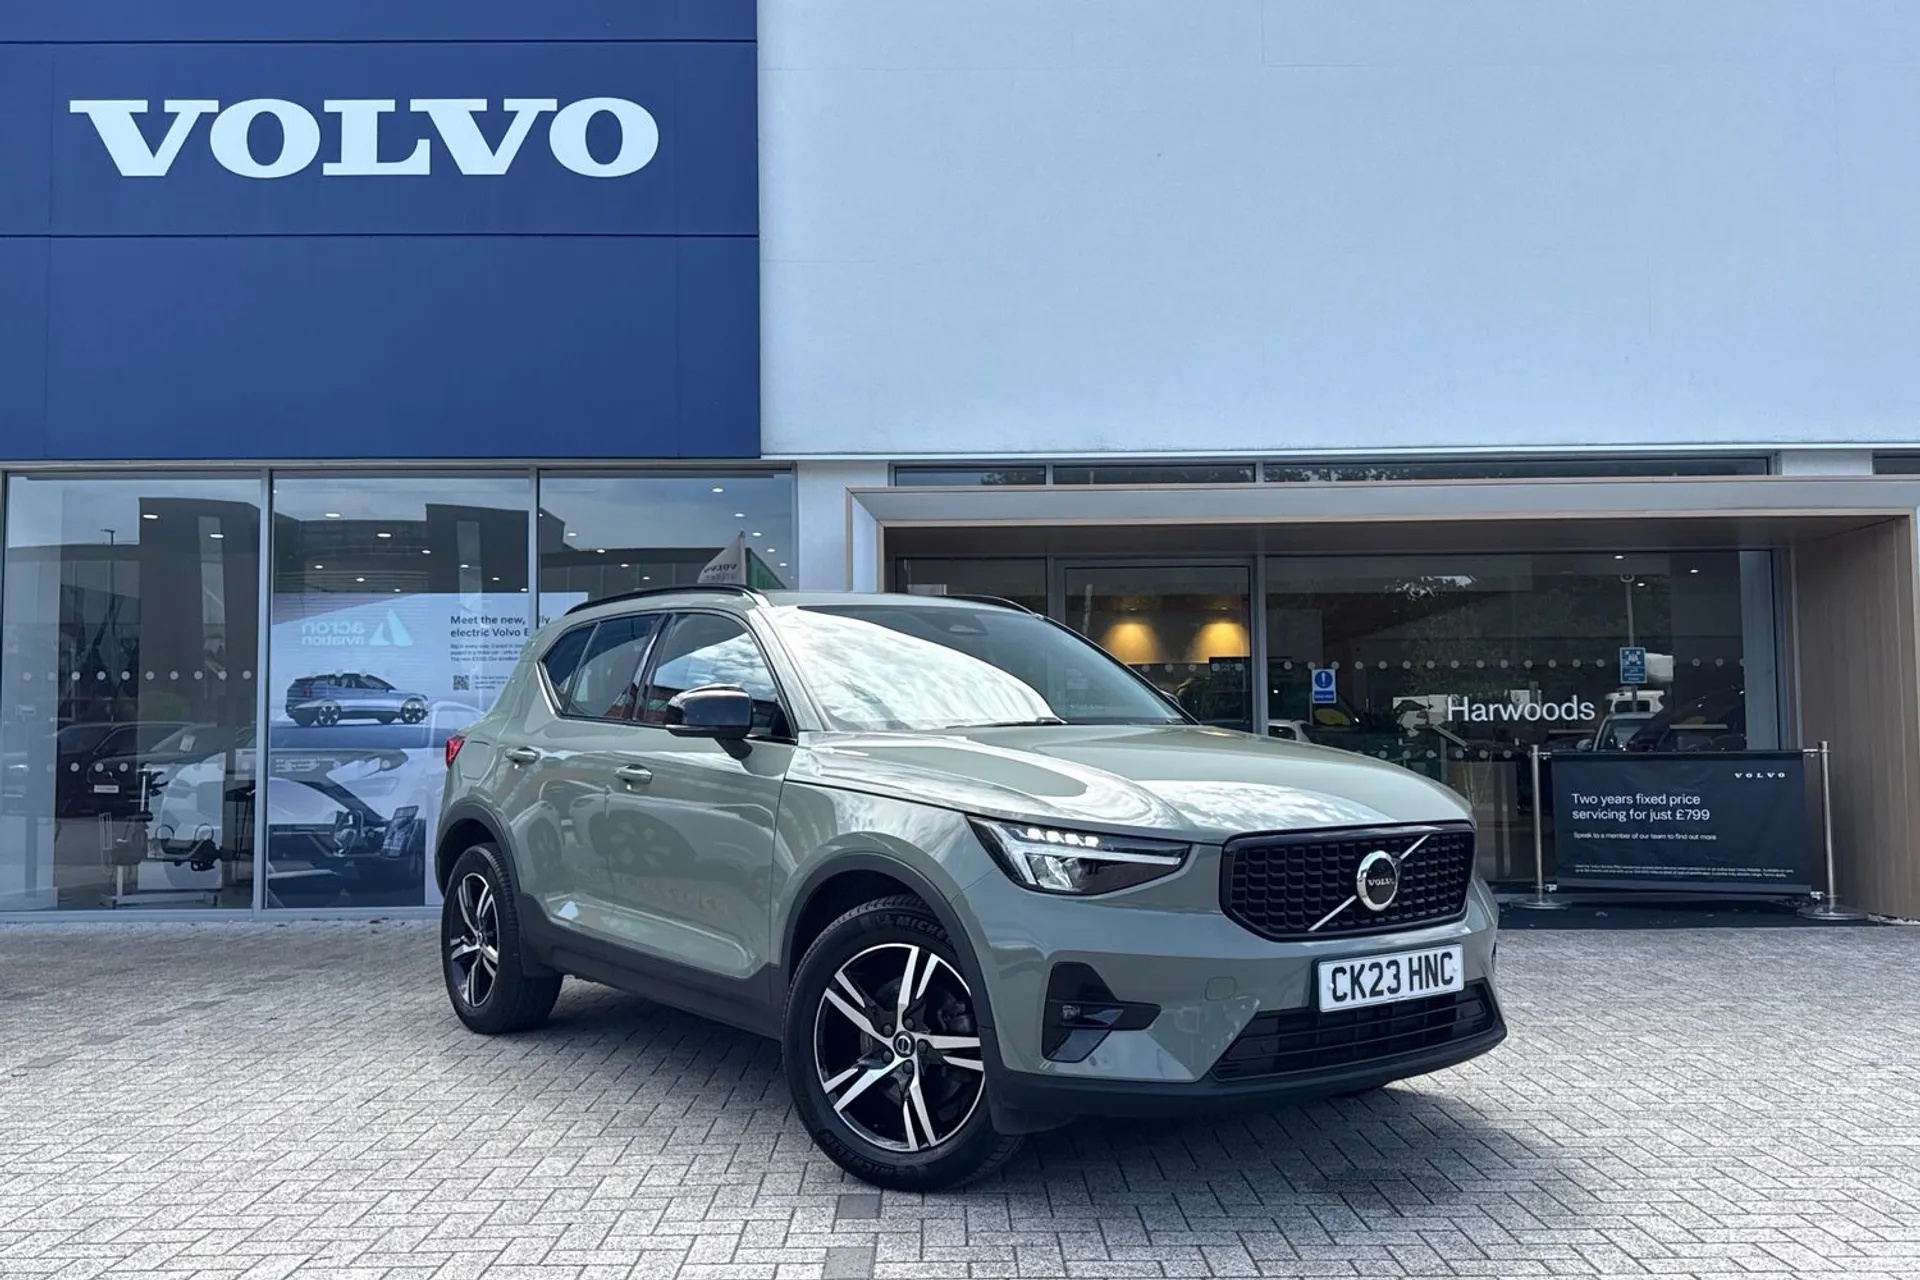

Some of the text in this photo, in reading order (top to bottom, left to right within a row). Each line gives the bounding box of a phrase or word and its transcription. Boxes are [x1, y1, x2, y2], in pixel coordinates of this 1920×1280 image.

[70, 97, 659, 178] VOLVO
[450, 616, 525, 625] Meet the new,
[450, 628, 489, 637] electric
[492, 628, 521, 637] Volvo
[1447, 695, 1595, 721] Harwoods
[1572, 793, 1701, 806] Two years fixed price
[1572, 808, 1710, 822] servicing for just £799
[1573, 831, 1592, 839] Speak
[1675, 832, 1688, 840] find
[1331, 952, 1454, 1002] CK23 HNC
